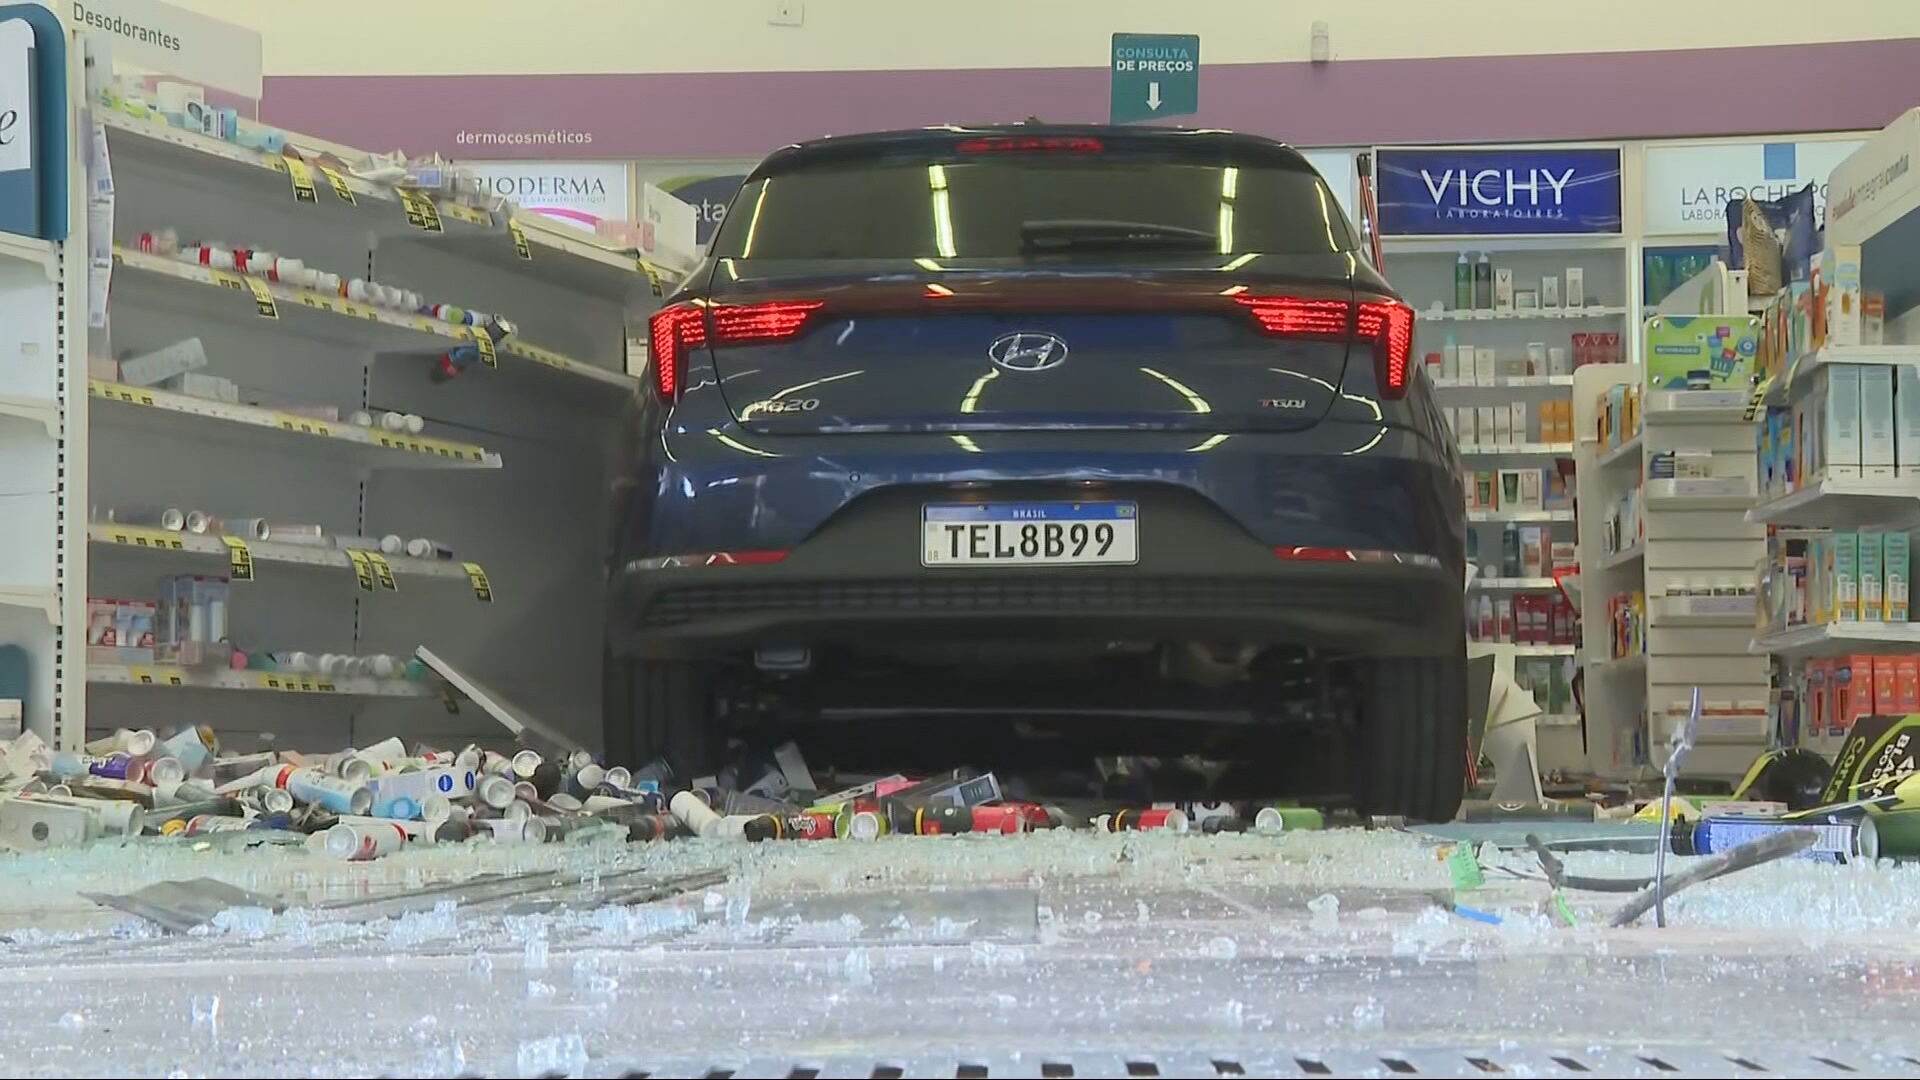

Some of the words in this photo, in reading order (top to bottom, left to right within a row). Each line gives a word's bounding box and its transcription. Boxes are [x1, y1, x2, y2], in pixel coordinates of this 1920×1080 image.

[73, 1, 181, 51] Desodorantes
[1116, 48, 1189, 59] CONSULTA
[1116, 60, 1135, 71] DE
[1139, 60, 1194, 74] PREÇOS
[456, 129, 592, 145] dermocosméticos
[1420, 168, 1575, 206] VICHY
[1682, 187, 1710, 206] LA
[1436, 209, 1563, 219] LABORATOIRES
[1012, 509, 1047, 519] BRASIL
[944, 523, 1114, 558] TEL8B99
